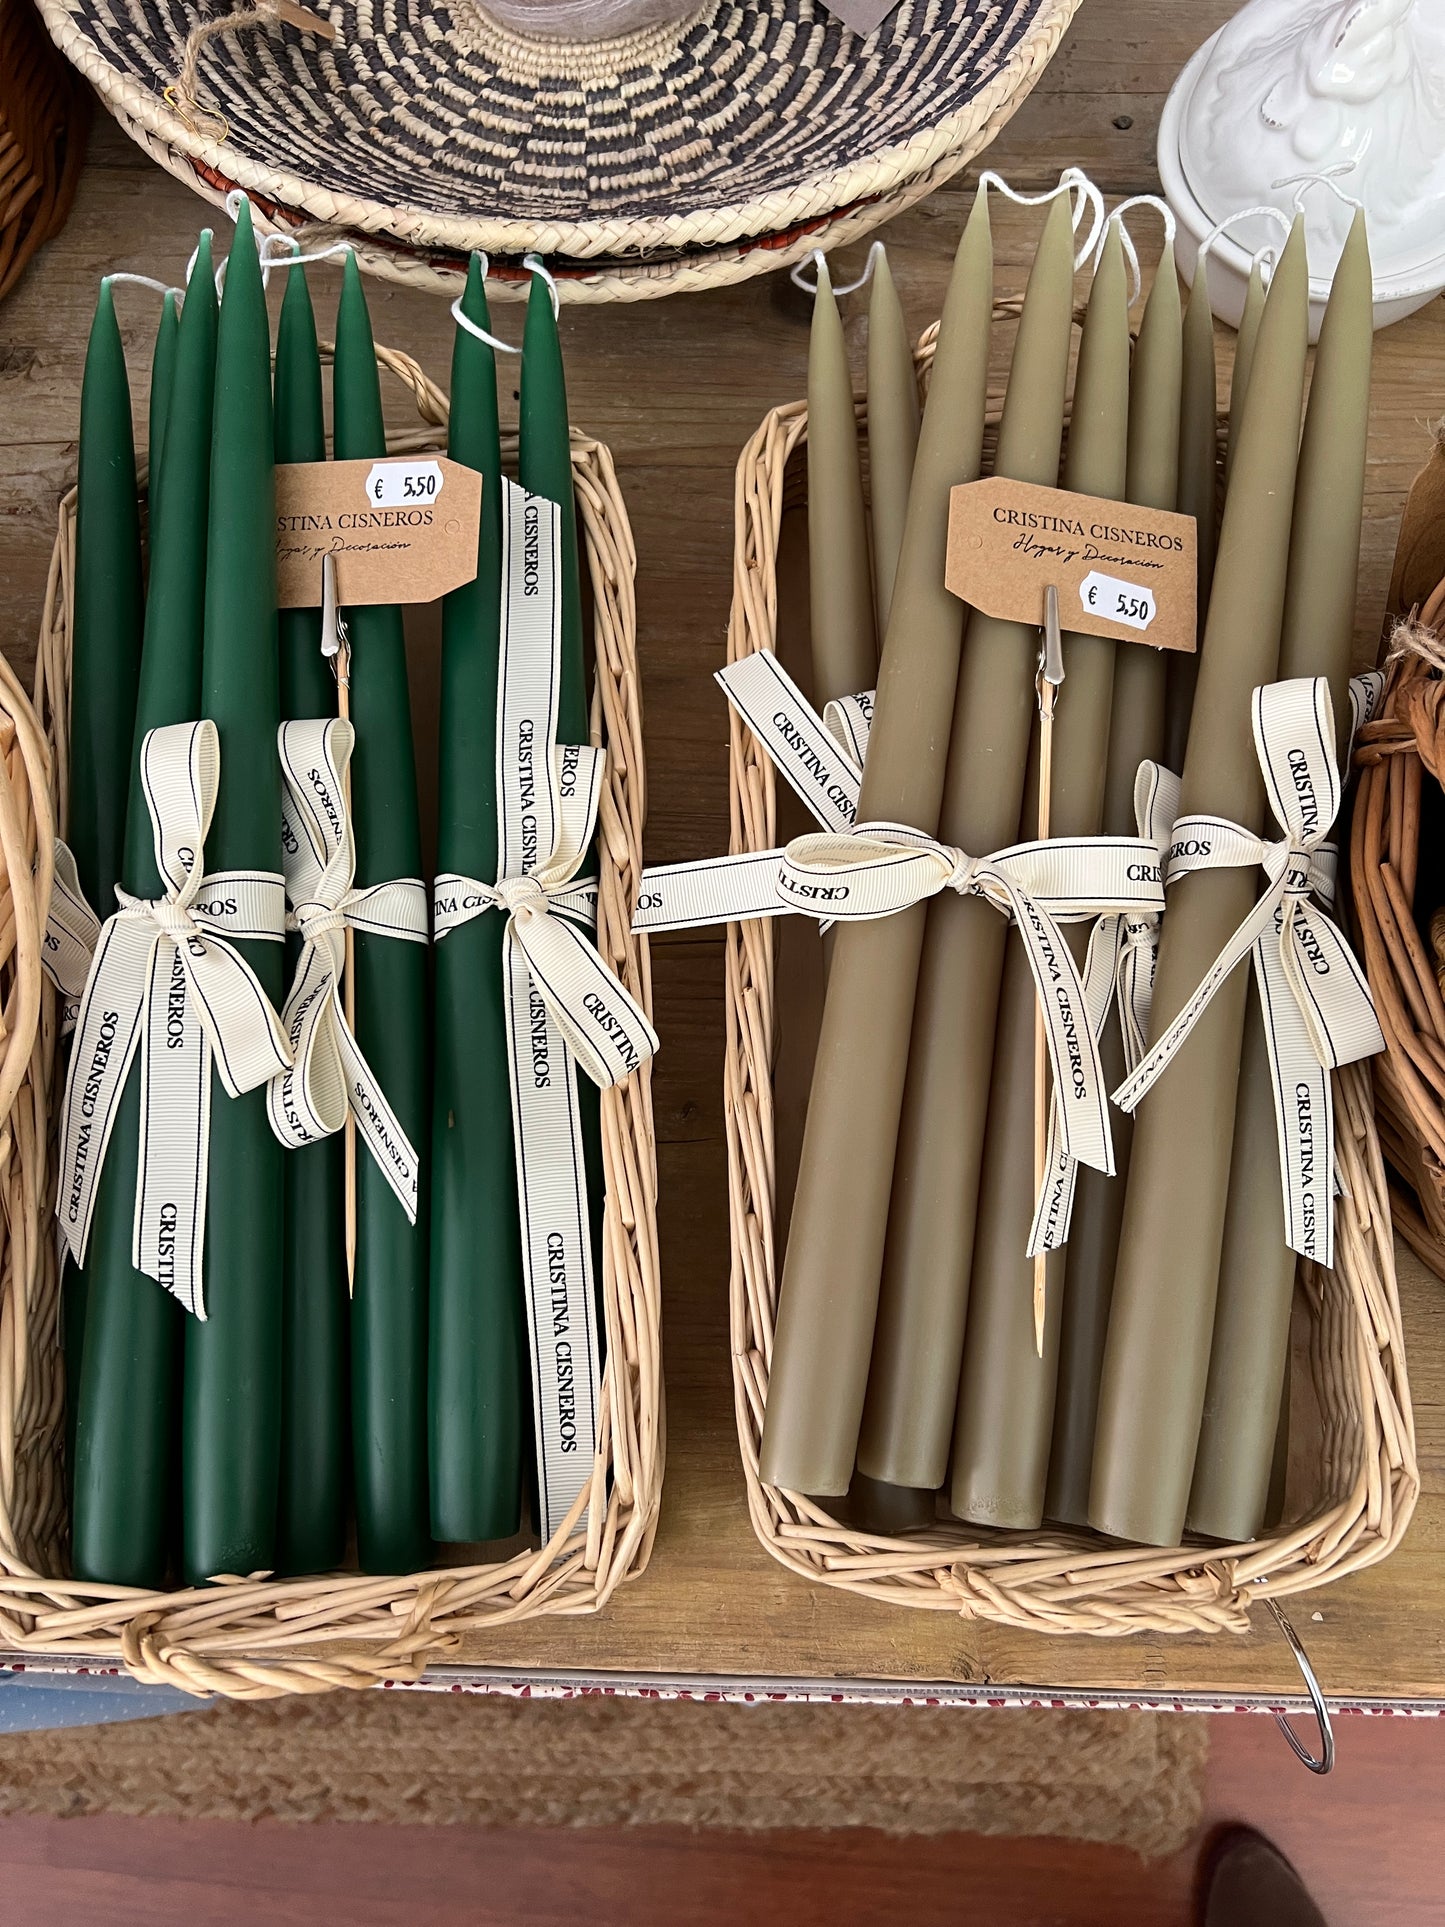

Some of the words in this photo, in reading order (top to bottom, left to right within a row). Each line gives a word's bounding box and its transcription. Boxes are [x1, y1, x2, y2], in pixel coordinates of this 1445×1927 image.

[277, 514, 333, 532] STINA
[338, 510, 433, 529] CISNEROS
[374, 478, 384, 499] €
[403, 474, 436, 498] 5,50
[993, 507, 1085, 536] CRISTINA
[1090, 524, 1183, 552] CISNEROS
[327, 536, 411, 554] Decoración
[524, 505, 539, 597] CISNEROS
[1013, 532, 1067, 558] Hogar
[1063, 550, 1079, 563] y
[1082, 543, 1164, 569] Decoración
[1088, 586, 1098, 605] €
[1116, 594, 1149, 621] 5,50
[518, 719, 535, 812] CRISTINA
[772, 711, 831, 788] CRISTINA
[827, 784, 858, 827] CISN
[1287, 748, 1319, 847] CRISTINA
[521, 815, 537, 875] CISNE
[582, 992, 641, 1073] CRISTINA
[1016, 887, 1062, 982] CRISTINA
[1056, 986, 1087, 1100] CISNEROS
[68, 1123, 92, 1224] CRISTINA
[81, 1011, 119, 1118] CISNEROS
[354, 1082, 410, 1178] CISNEROS
[1295, 1082, 1314, 1189] CRISTINA
[547, 1231, 569, 1335] CRISTINA
[555, 1341, 577, 1453] CISNEROS
